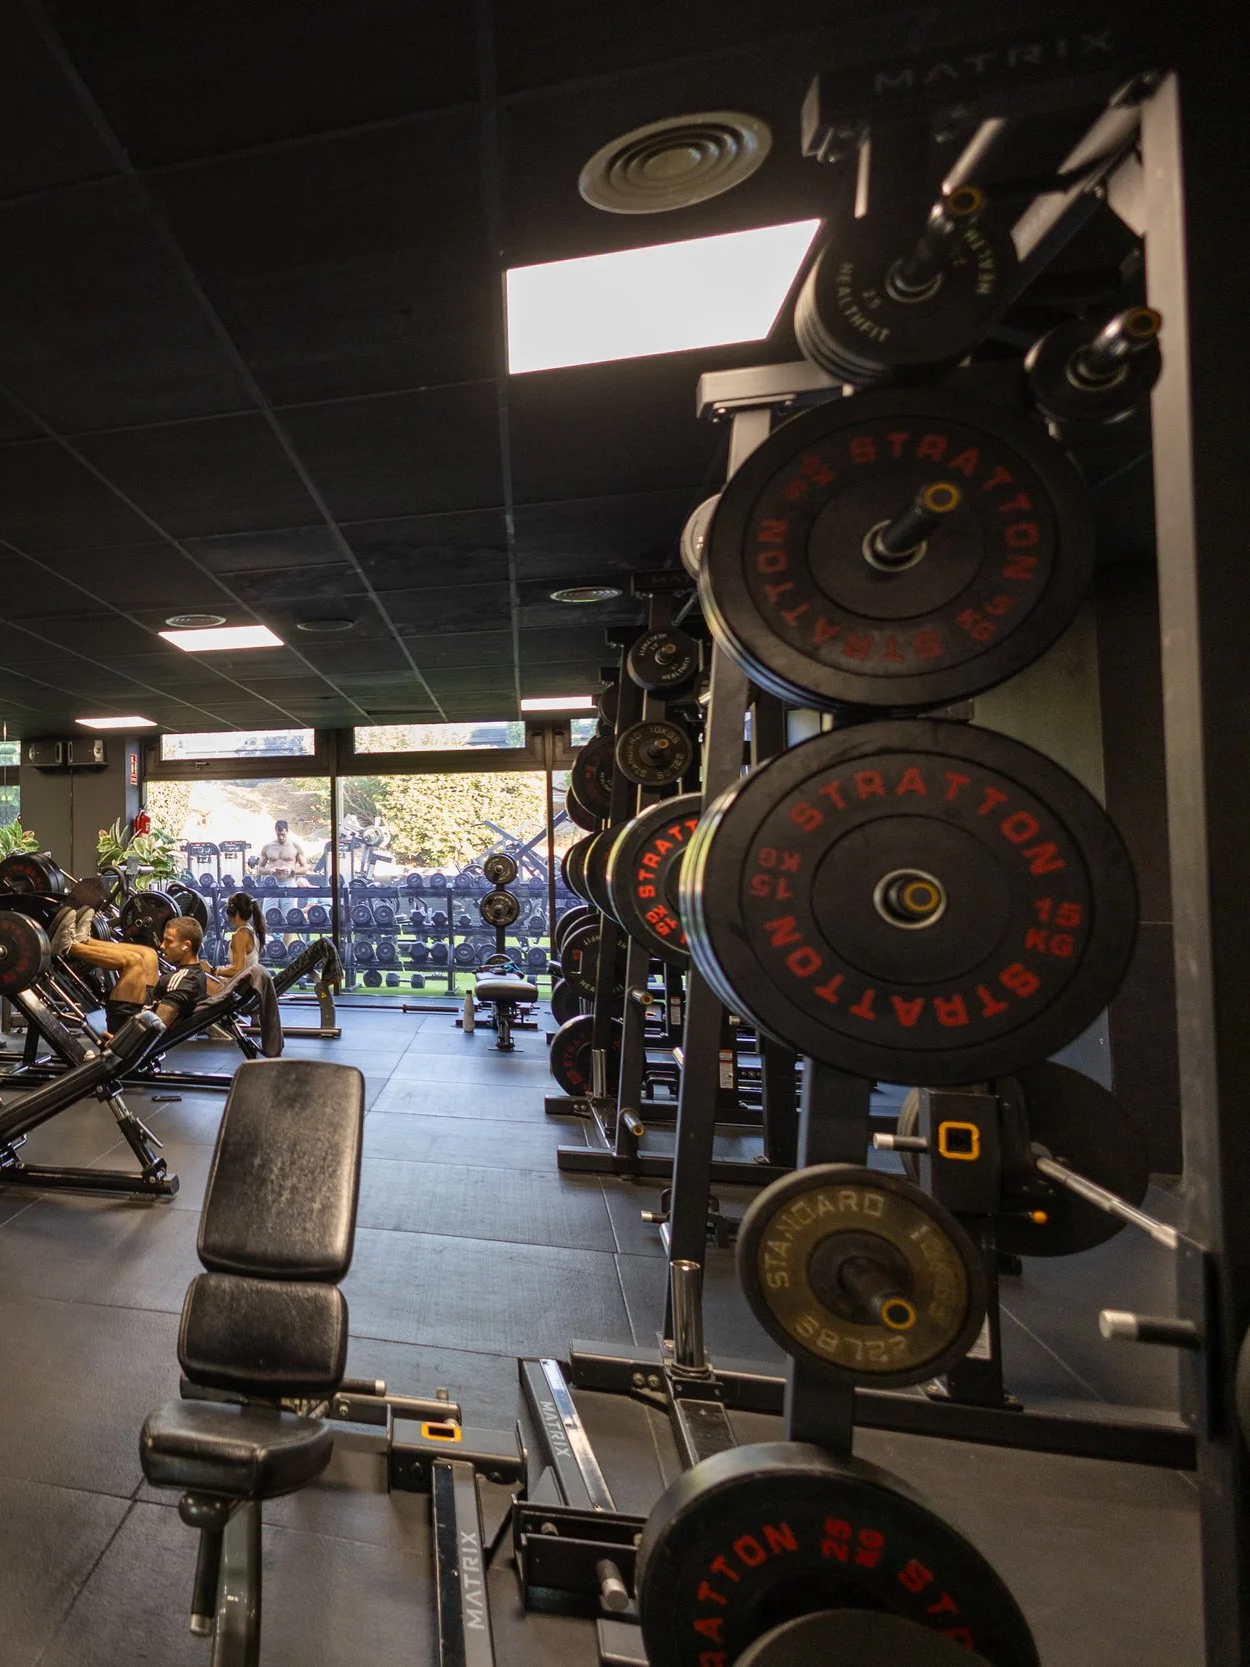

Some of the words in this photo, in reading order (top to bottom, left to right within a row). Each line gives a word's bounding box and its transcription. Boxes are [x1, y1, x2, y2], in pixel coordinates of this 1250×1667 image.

[875, 29, 1112, 95] MATRIX
[849, 431, 1040, 582] STRATTON
[756, 518, 944, 661] STRATTON
[789, 767, 1068, 877] STRATTON
[752, 873, 792, 900] 15
[757, 847, 801, 872] KG
[1024, 927, 1075, 959] KG
[1036, 897, 1082, 928] 15
[764, 914, 1041, 1028] STRATTON
[764, 1190, 885, 1289] STANDARD
[541, 1400, 572, 1458] MATRIX
[821, 1514, 851, 1563] 25
[854, 1527, 885, 1568] KG
[460, 1531, 485, 1630] MATRIX
